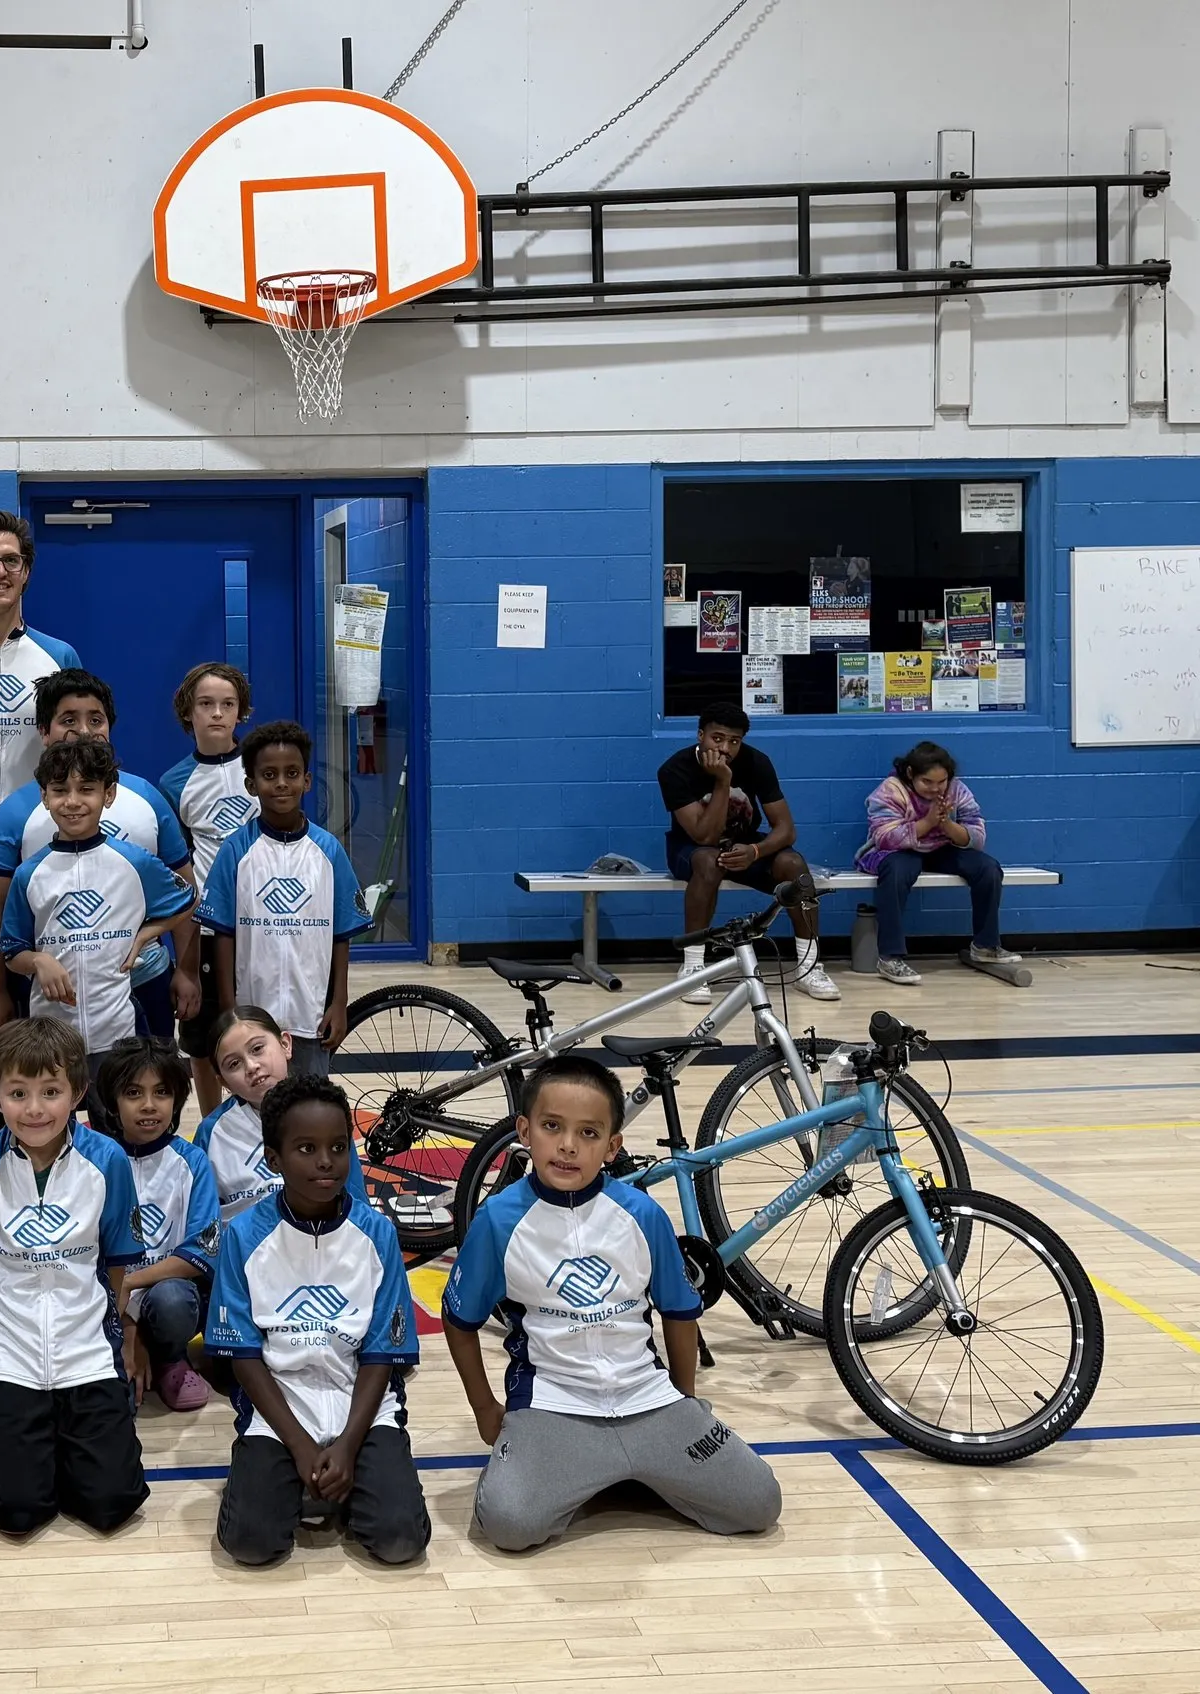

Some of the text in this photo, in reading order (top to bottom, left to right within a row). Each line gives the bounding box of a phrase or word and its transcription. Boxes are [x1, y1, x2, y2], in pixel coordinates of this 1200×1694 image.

[1138, 557, 1188, 576] BIKE
[840, 596, 868, 604] SHOOT
[240, 917, 330, 926] BOYS & GIRLS CLUBS
[58, 936, 66, 944] &
[68, 933, 100, 943] GIRLS
[102, 929, 132, 940] CLUBS
[72, 944, 101, 952] TUCSON
[31, 1250, 60, 1262] GIRLS
[570, 1311, 580, 1322] &
[581, 1306, 612, 1323] GIRLS
[301, 1322, 338, 1334] GIRLS
[568, 1324, 580, 1334] OF
[290, 1338, 302, 1346] OF
[1042, 1386, 1080, 1430] KENDA
